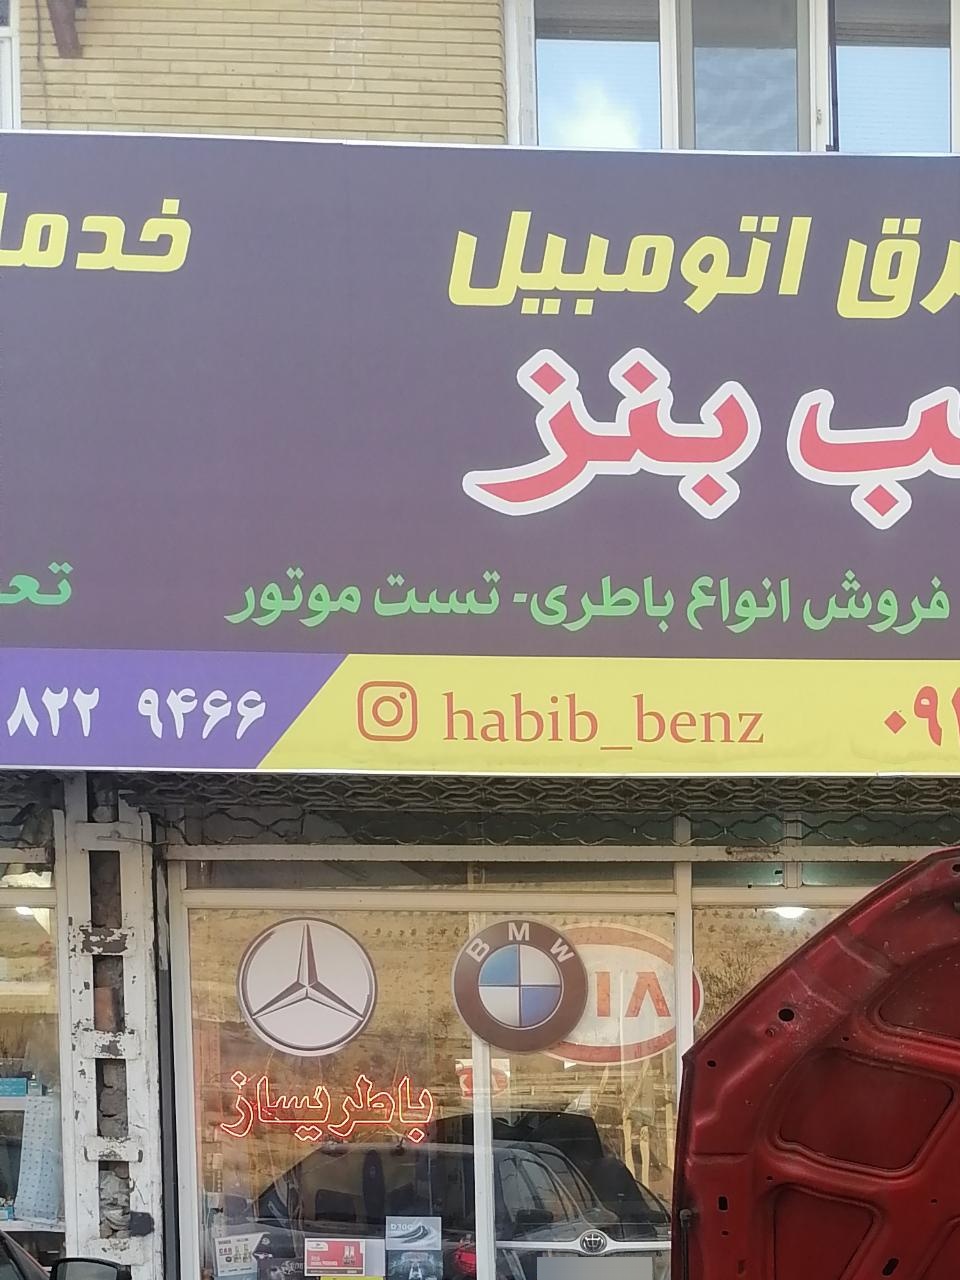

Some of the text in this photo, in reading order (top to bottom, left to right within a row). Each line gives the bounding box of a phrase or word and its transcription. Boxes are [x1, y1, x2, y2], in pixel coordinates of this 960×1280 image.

[0, 192, 191, 274] خدم
[448, 210, 812, 317] اتومبیل
[462, 348, 762, 520] بنز
[224, 567, 362, 628] موتور
[373, 570, 501, 617] تست
[686, 575, 791, 634] انواع
[802, 569, 951, 635] فروش
[443, 692, 765, 750] habib_benz
[465, 922, 576, 964] BMW
[595, 971, 672, 1018] IA
